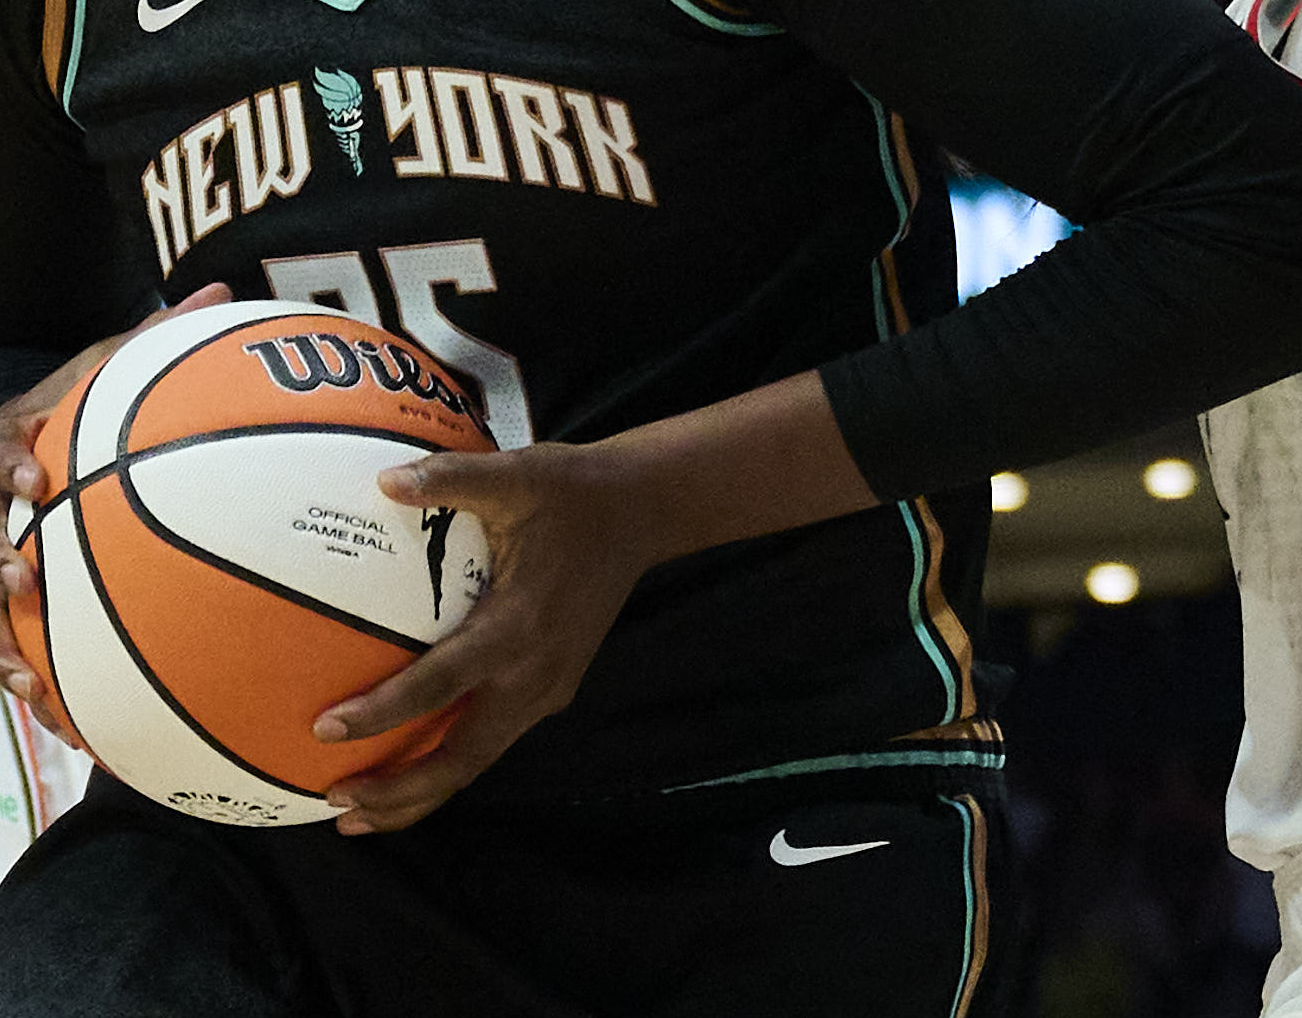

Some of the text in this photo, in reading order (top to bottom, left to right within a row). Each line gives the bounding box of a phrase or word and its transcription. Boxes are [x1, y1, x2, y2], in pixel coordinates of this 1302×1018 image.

[141, 66, 658, 280] NEW YORK
[293, 519, 398, 555] GAME BALL
[308, 506, 390, 535] OFFICIAL
